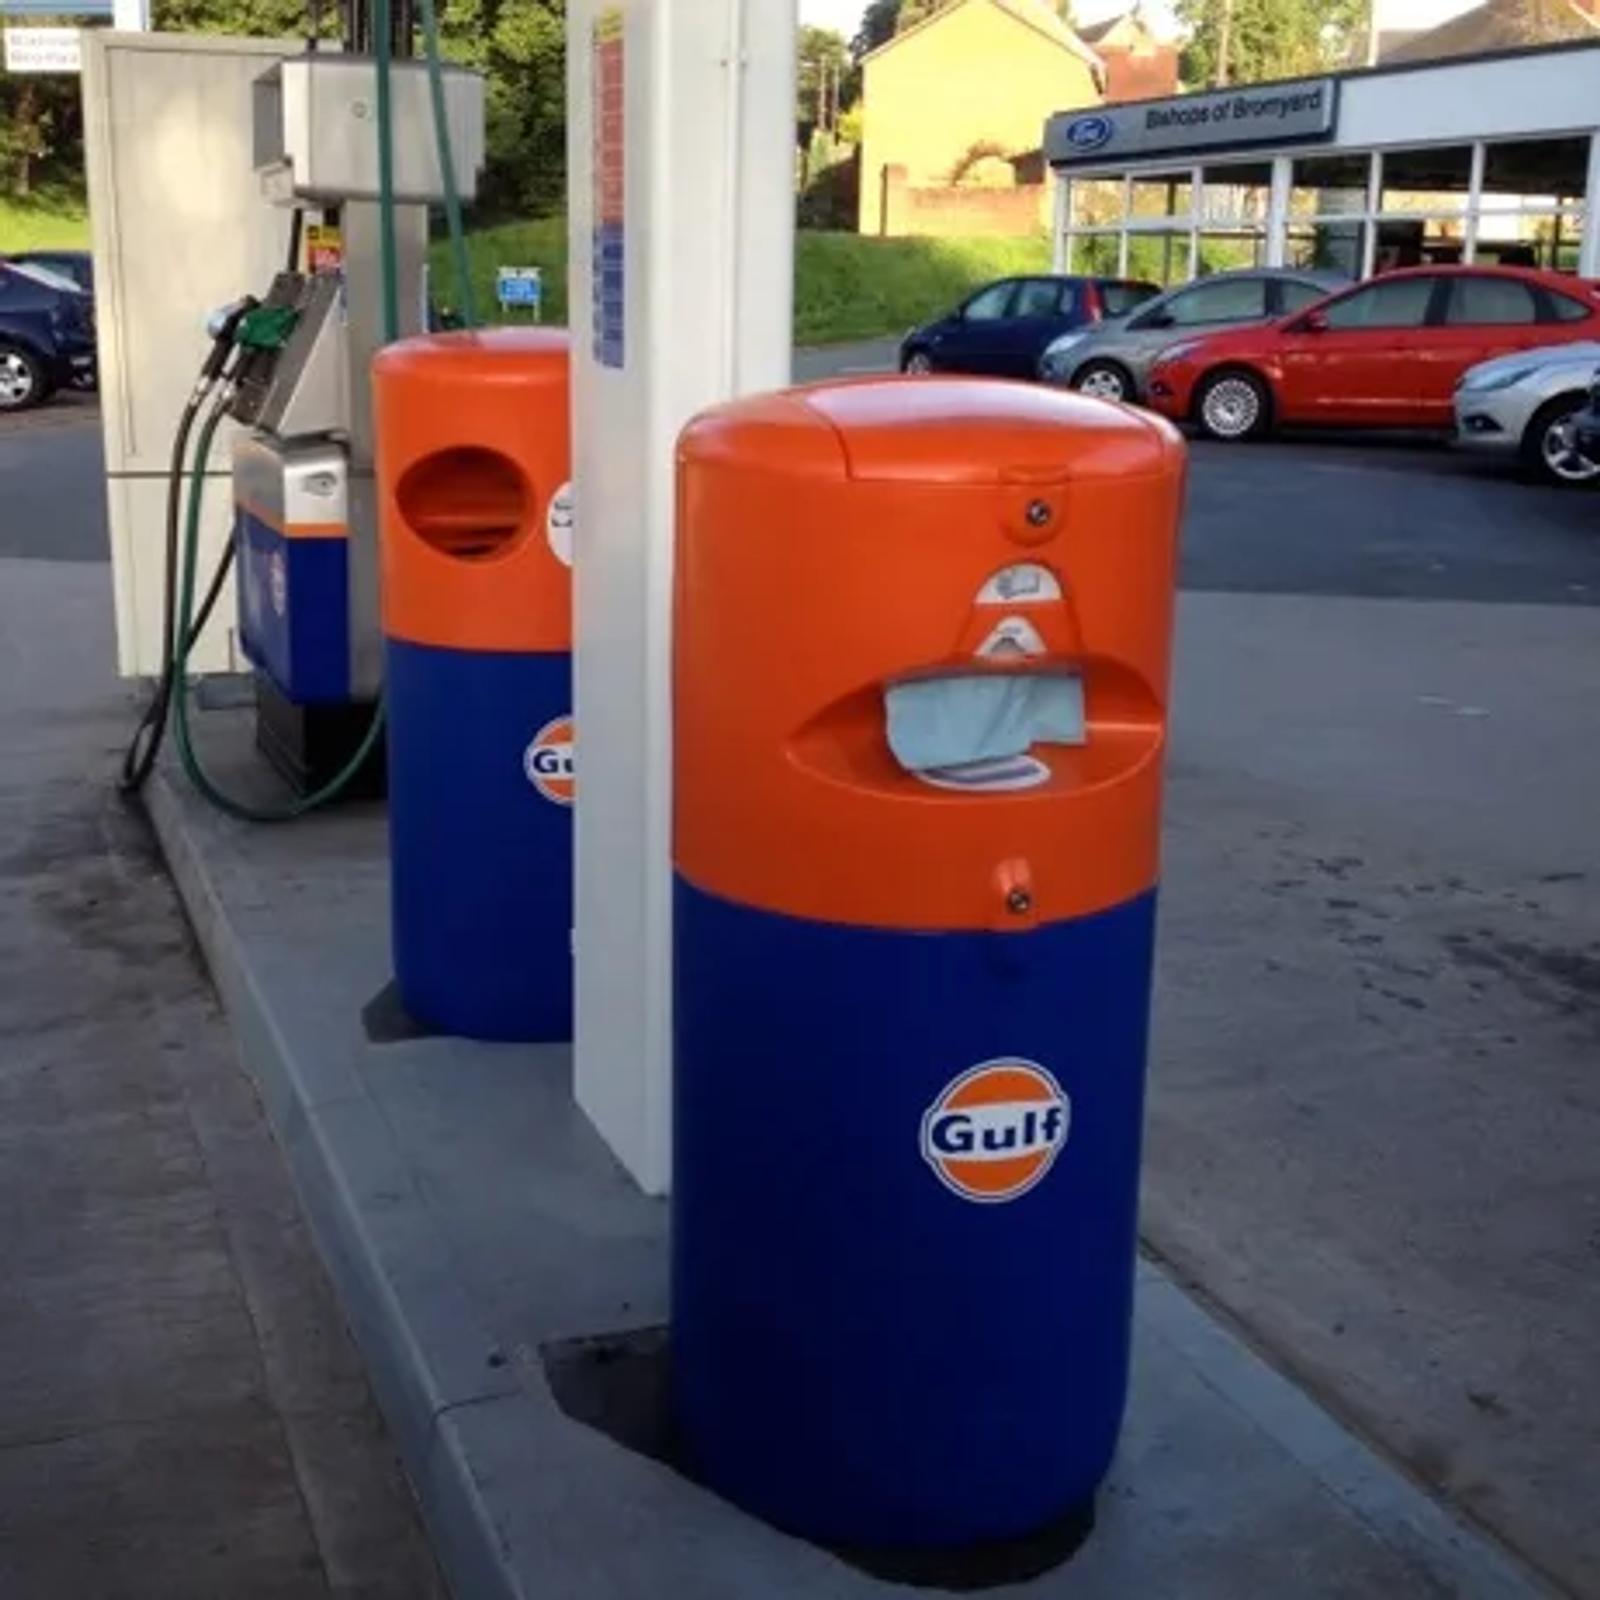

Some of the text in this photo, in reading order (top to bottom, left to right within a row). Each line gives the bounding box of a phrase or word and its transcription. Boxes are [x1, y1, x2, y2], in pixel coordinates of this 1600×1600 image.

[1146, 88, 1322, 129] Bishops of Bromyard
[931, 1107, 1061, 1153] Gulf
